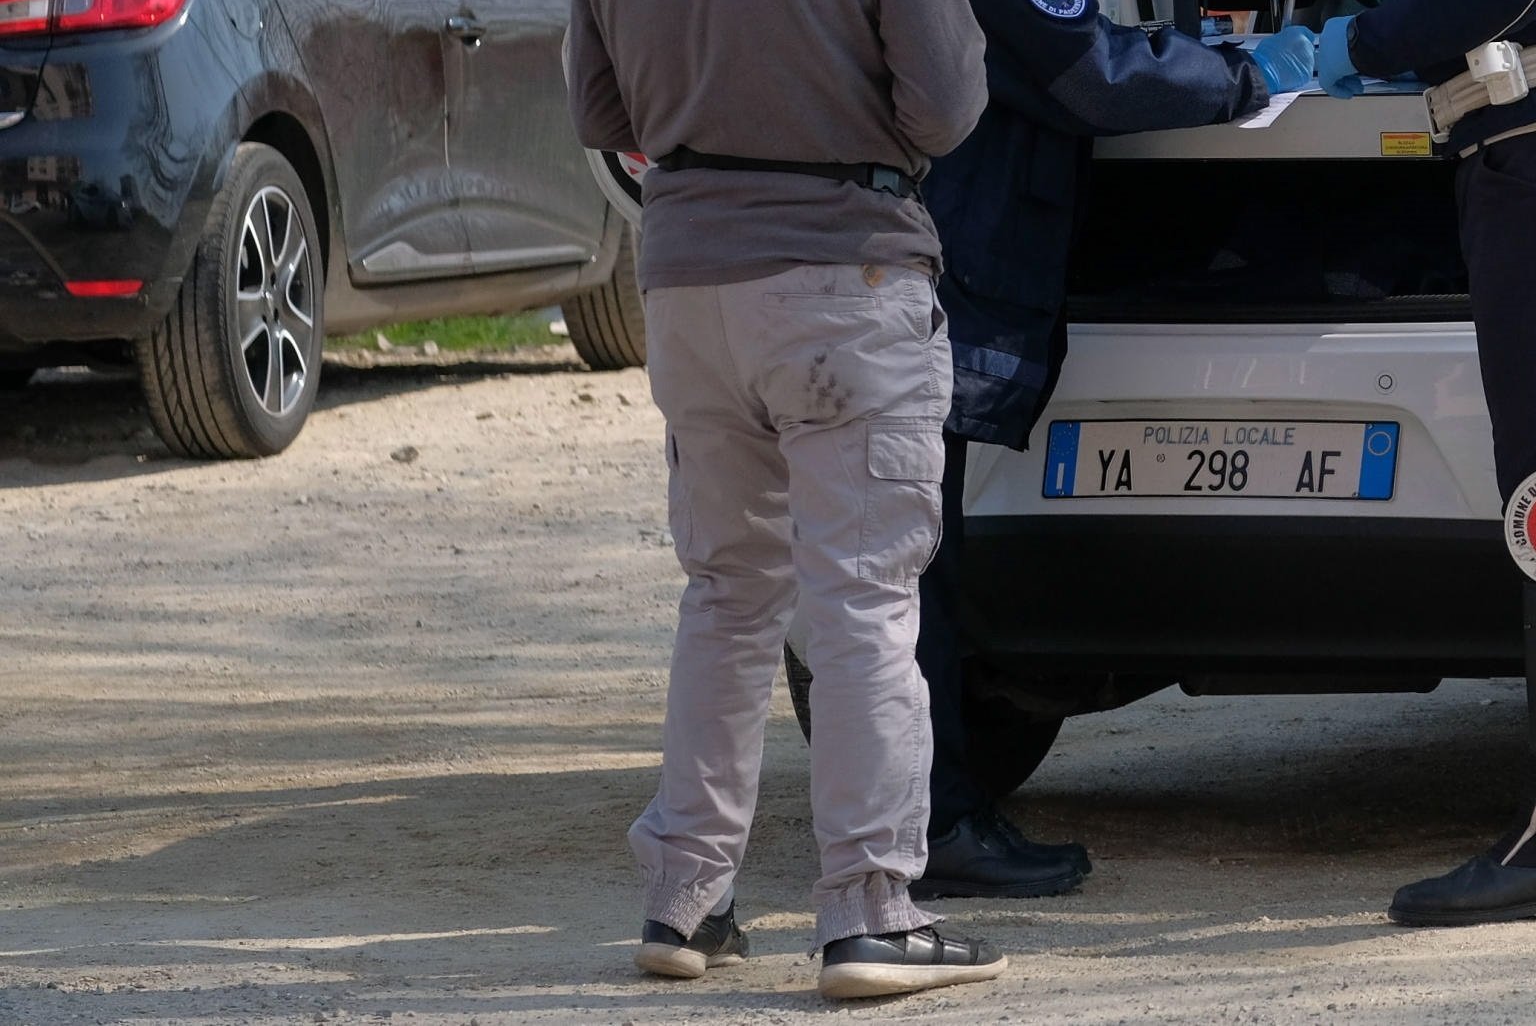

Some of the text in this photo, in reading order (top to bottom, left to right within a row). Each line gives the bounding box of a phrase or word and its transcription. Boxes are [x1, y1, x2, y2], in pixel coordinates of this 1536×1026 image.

[1048, 5, 1057, 13] DI
[1143, 426, 1296, 446] POLIZIA LOCALE
[1098, 449, 1133, 492] YA
[1183, 449, 1251, 492] 298
[1295, 450, 1342, 494] AF
[1513, 495, 1532, 547] COMUNE
